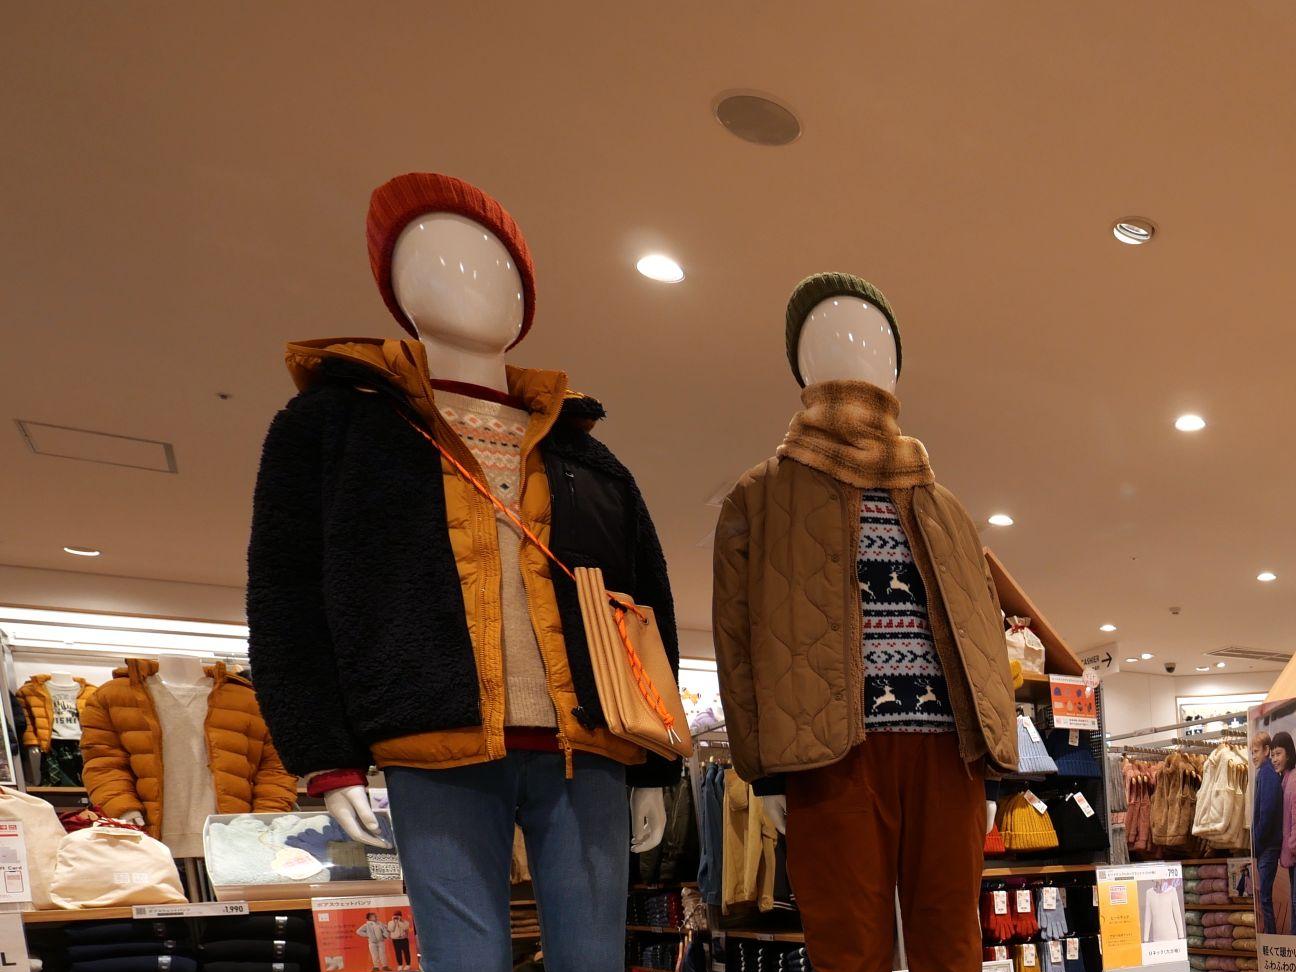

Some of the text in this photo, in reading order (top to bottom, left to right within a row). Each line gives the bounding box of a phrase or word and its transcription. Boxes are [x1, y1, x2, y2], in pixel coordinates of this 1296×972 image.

[1264, 961, 1296, 972] ふわふわの
